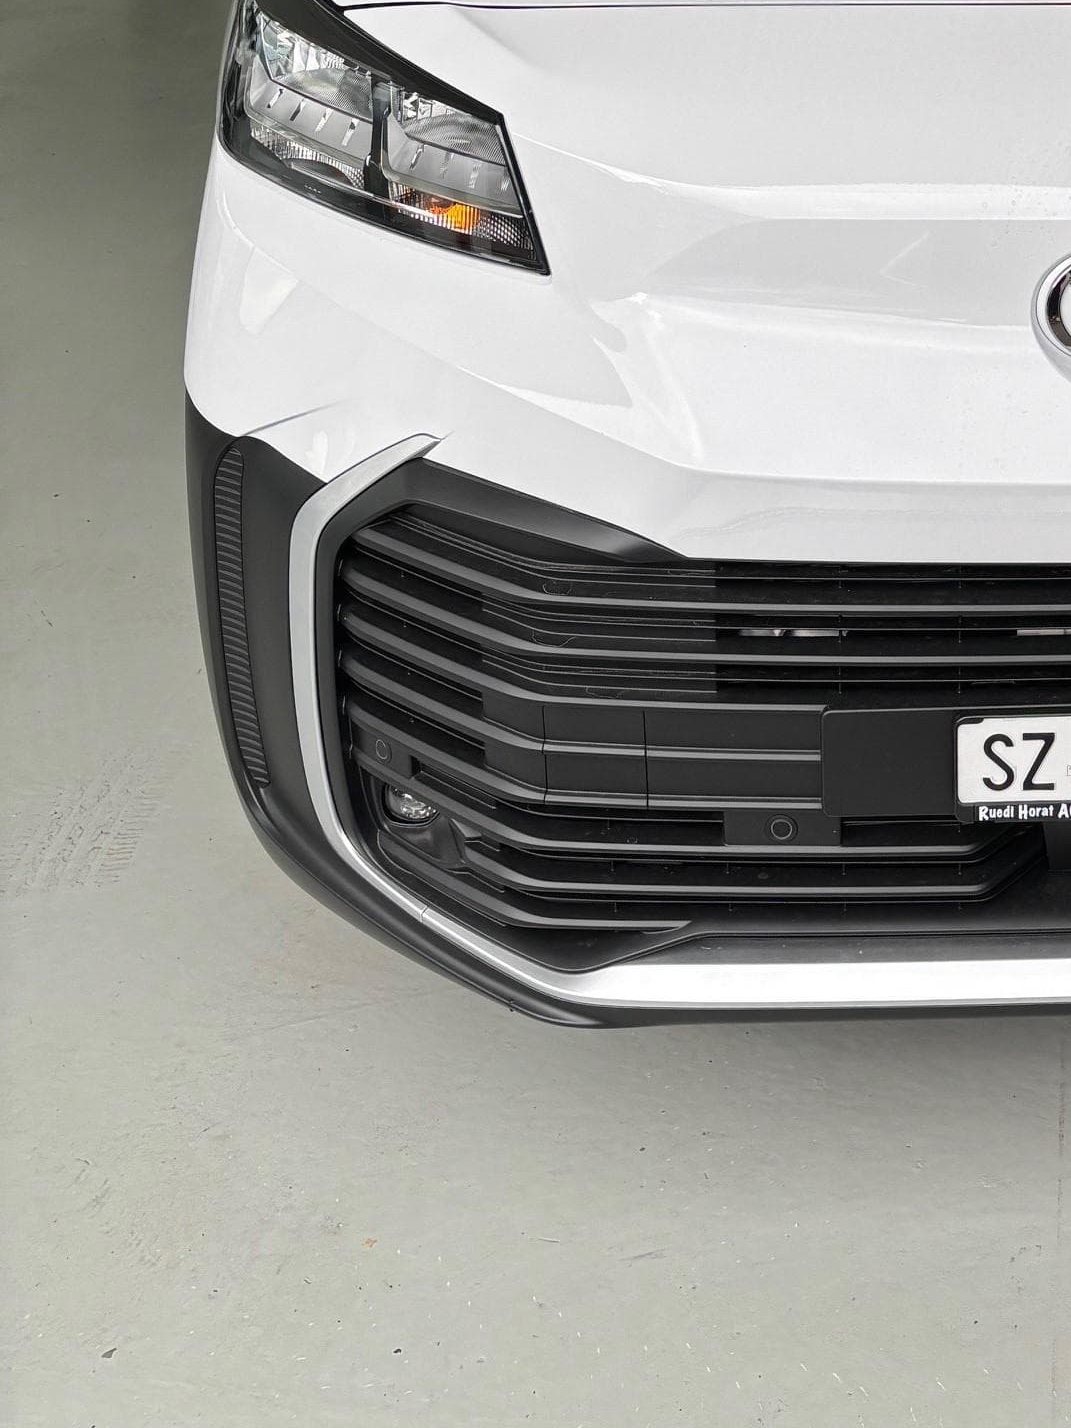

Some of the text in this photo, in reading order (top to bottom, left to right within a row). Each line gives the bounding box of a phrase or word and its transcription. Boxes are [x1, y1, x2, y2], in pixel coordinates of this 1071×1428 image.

[982, 732, 1056, 791] SZ
[978, 805, 1015, 821] Ruedi
[1018, 804, 1054, 820] Horat
